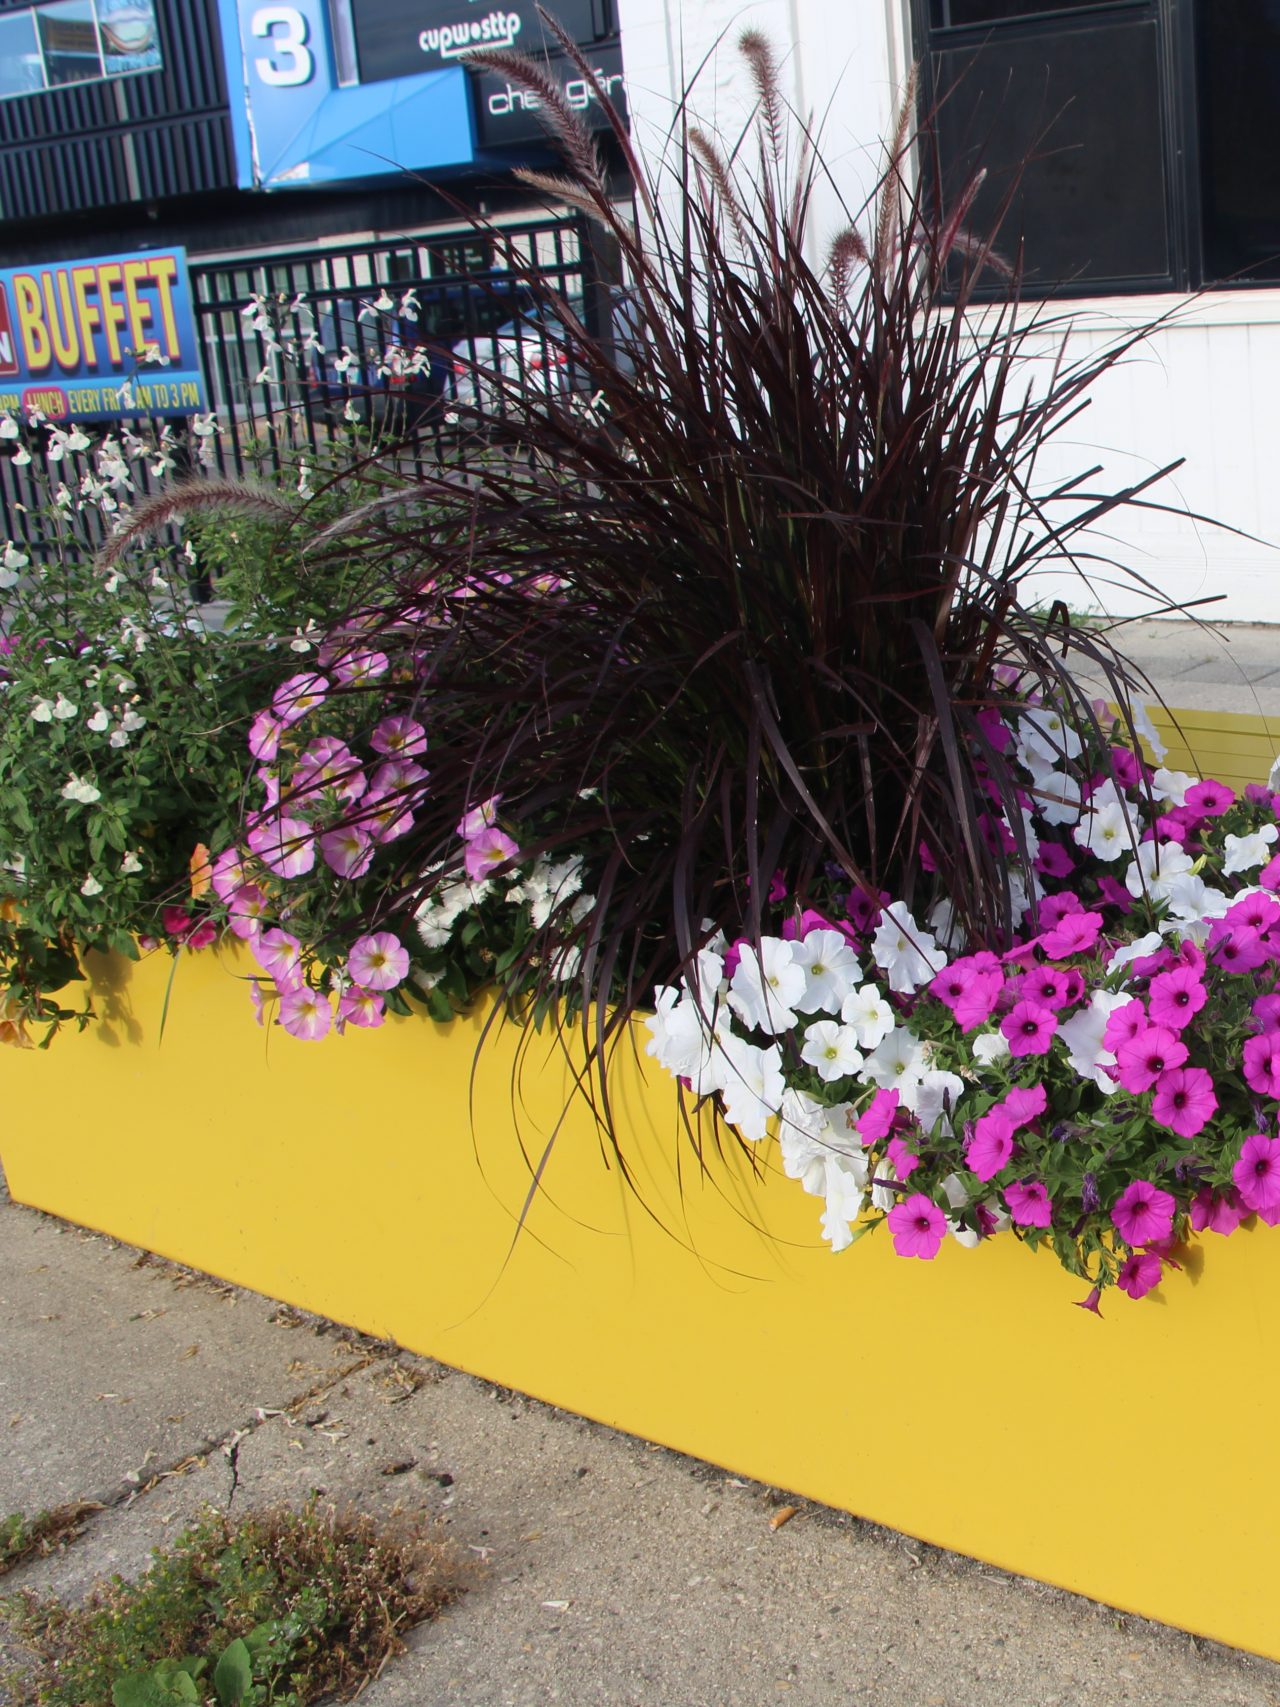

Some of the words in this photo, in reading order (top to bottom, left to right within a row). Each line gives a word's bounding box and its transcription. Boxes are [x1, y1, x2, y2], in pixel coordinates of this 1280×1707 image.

[252, 6, 313, 87] 3
[12, 256, 182, 372] BUFFET
[67, 389, 101, 413] EVERY
[154, 384, 169, 408] TO
[171, 383, 180, 407] 3
[181, 382, 200, 406] PM
